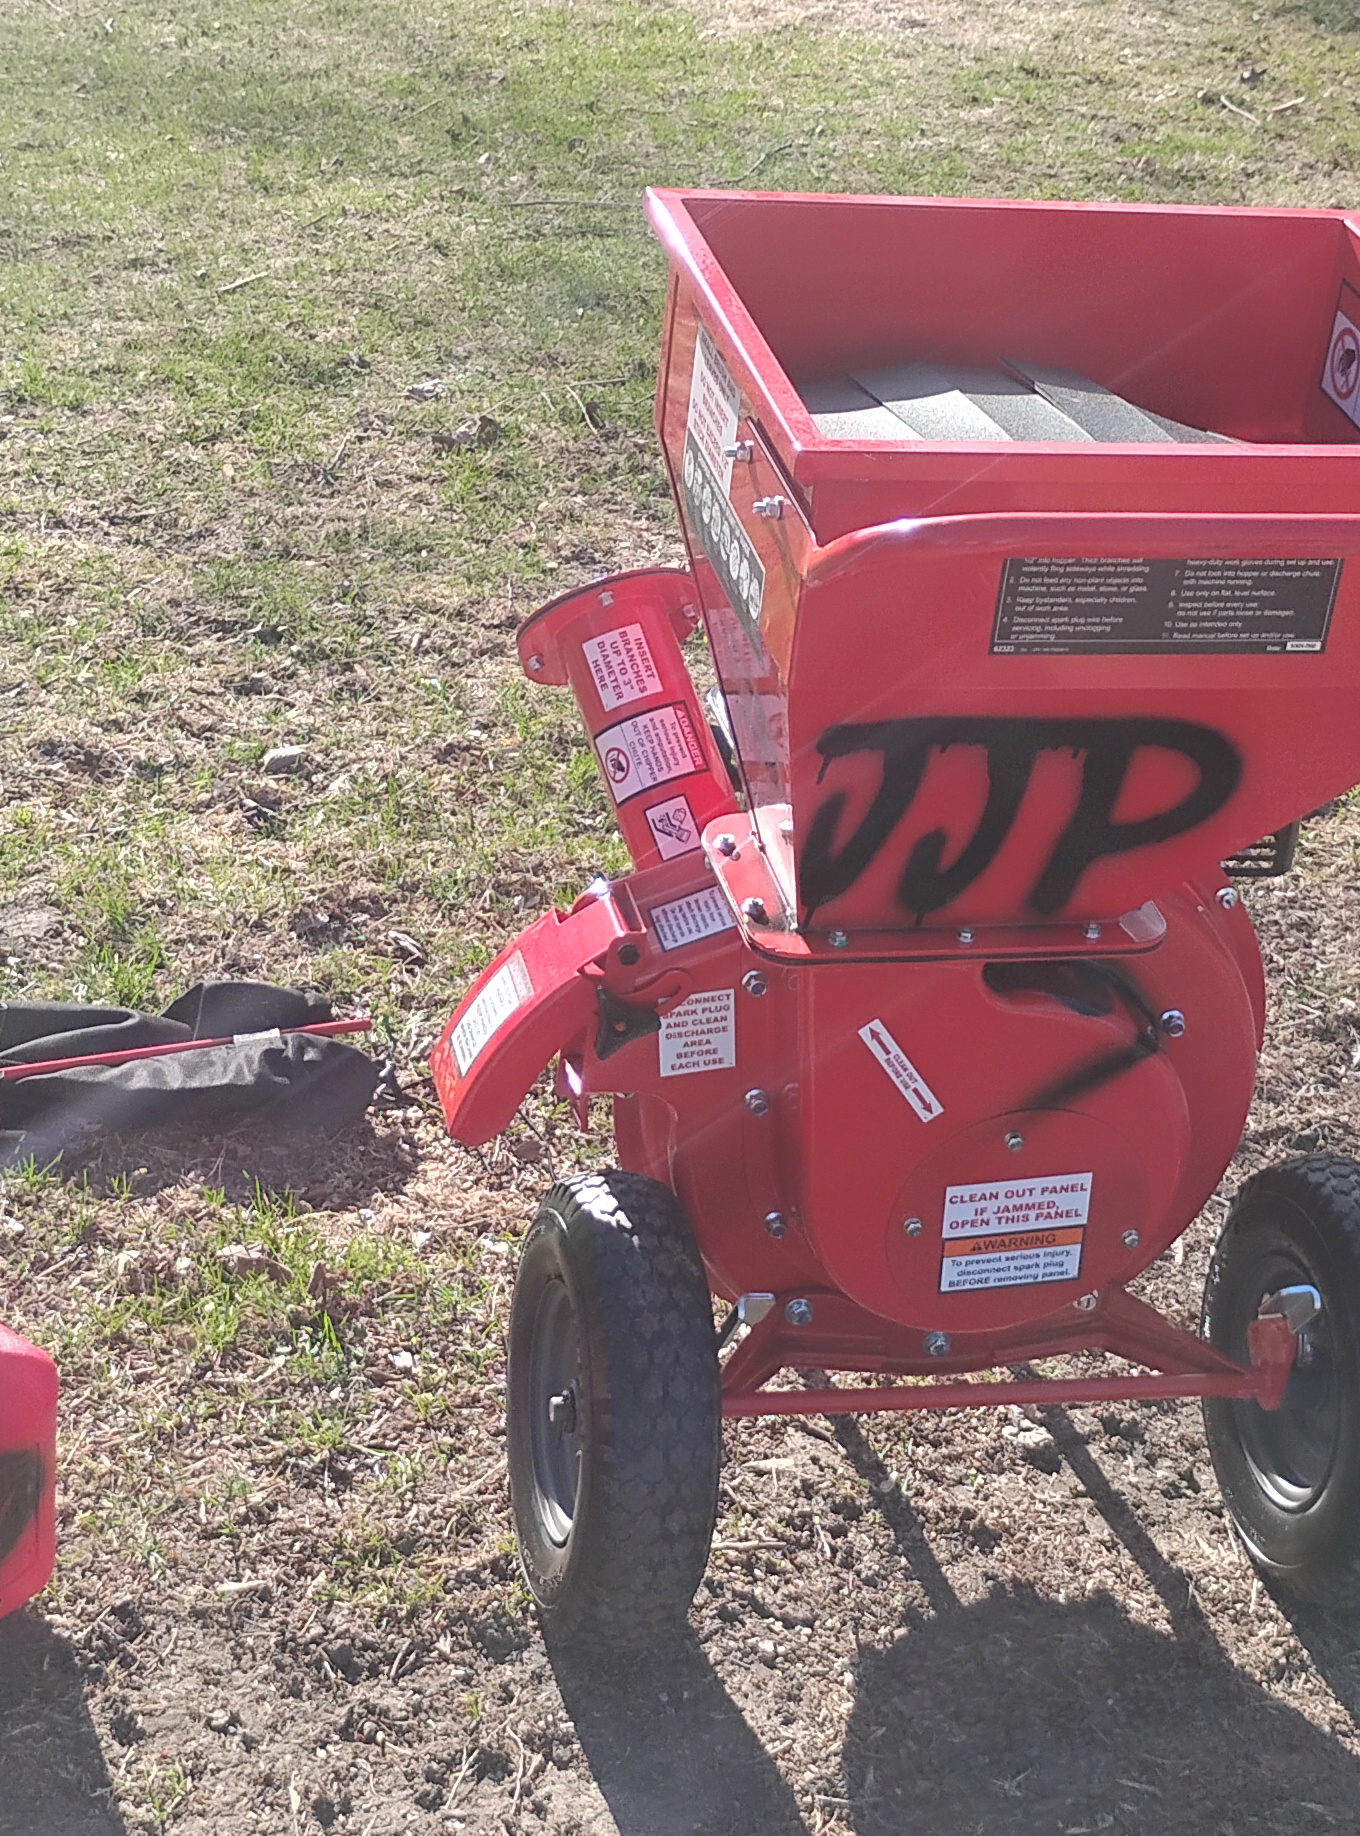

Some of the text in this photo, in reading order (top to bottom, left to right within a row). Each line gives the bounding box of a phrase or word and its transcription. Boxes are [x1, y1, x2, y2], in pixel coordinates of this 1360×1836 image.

[610, 641, 621, 657] UP
[617, 659, 628, 676] TO
[618, 630, 648, 694] BRANCHES
[634, 637, 656, 679] INSERT
[592, 659, 609, 692] HERE
[597, 640, 624, 701] DIAMETER
[631, 720, 658, 782] OUT OF CHIPPER
[642, 724, 664, 773] KEEP HANDS
[669, 721, 687, 759] To prevent
[678, 717, 703, 766] DANGER
[668, 744, 680, 766] injury
[798, 715, 1244, 924] JJP
[701, 1003, 731, 1014] PLUG
[665, 1015, 728, 1030] AND CLEAN
[665, 1025, 729, 1040] DISCHARGE
[675, 1047, 719, 1060] BEFORE
[682, 1038, 712, 1048] AREA
[670, 1057, 725, 1071] EACH USE
[884, 1057, 912, 1091] BEFORE USE
[893, 1053, 918, 1085] CLEAN OUT
[948, 1182, 1089, 1206] CLEAN OUT PANEL
[948, 1208, 1083, 1231] OPEN THIS PANEL
[973, 1199, 1061, 1217] IF JAMMED,
[982, 1233, 1057, 1252] WARNING
[950, 1258, 964, 1268] To
[964, 1255, 1003, 1268] prevent
[1004, 1251, 1041, 1262] serious
[956, 1258, 1066, 1278] disconnect spark plug
[947, 1267, 1072, 1288] BEFORE removing panel.
